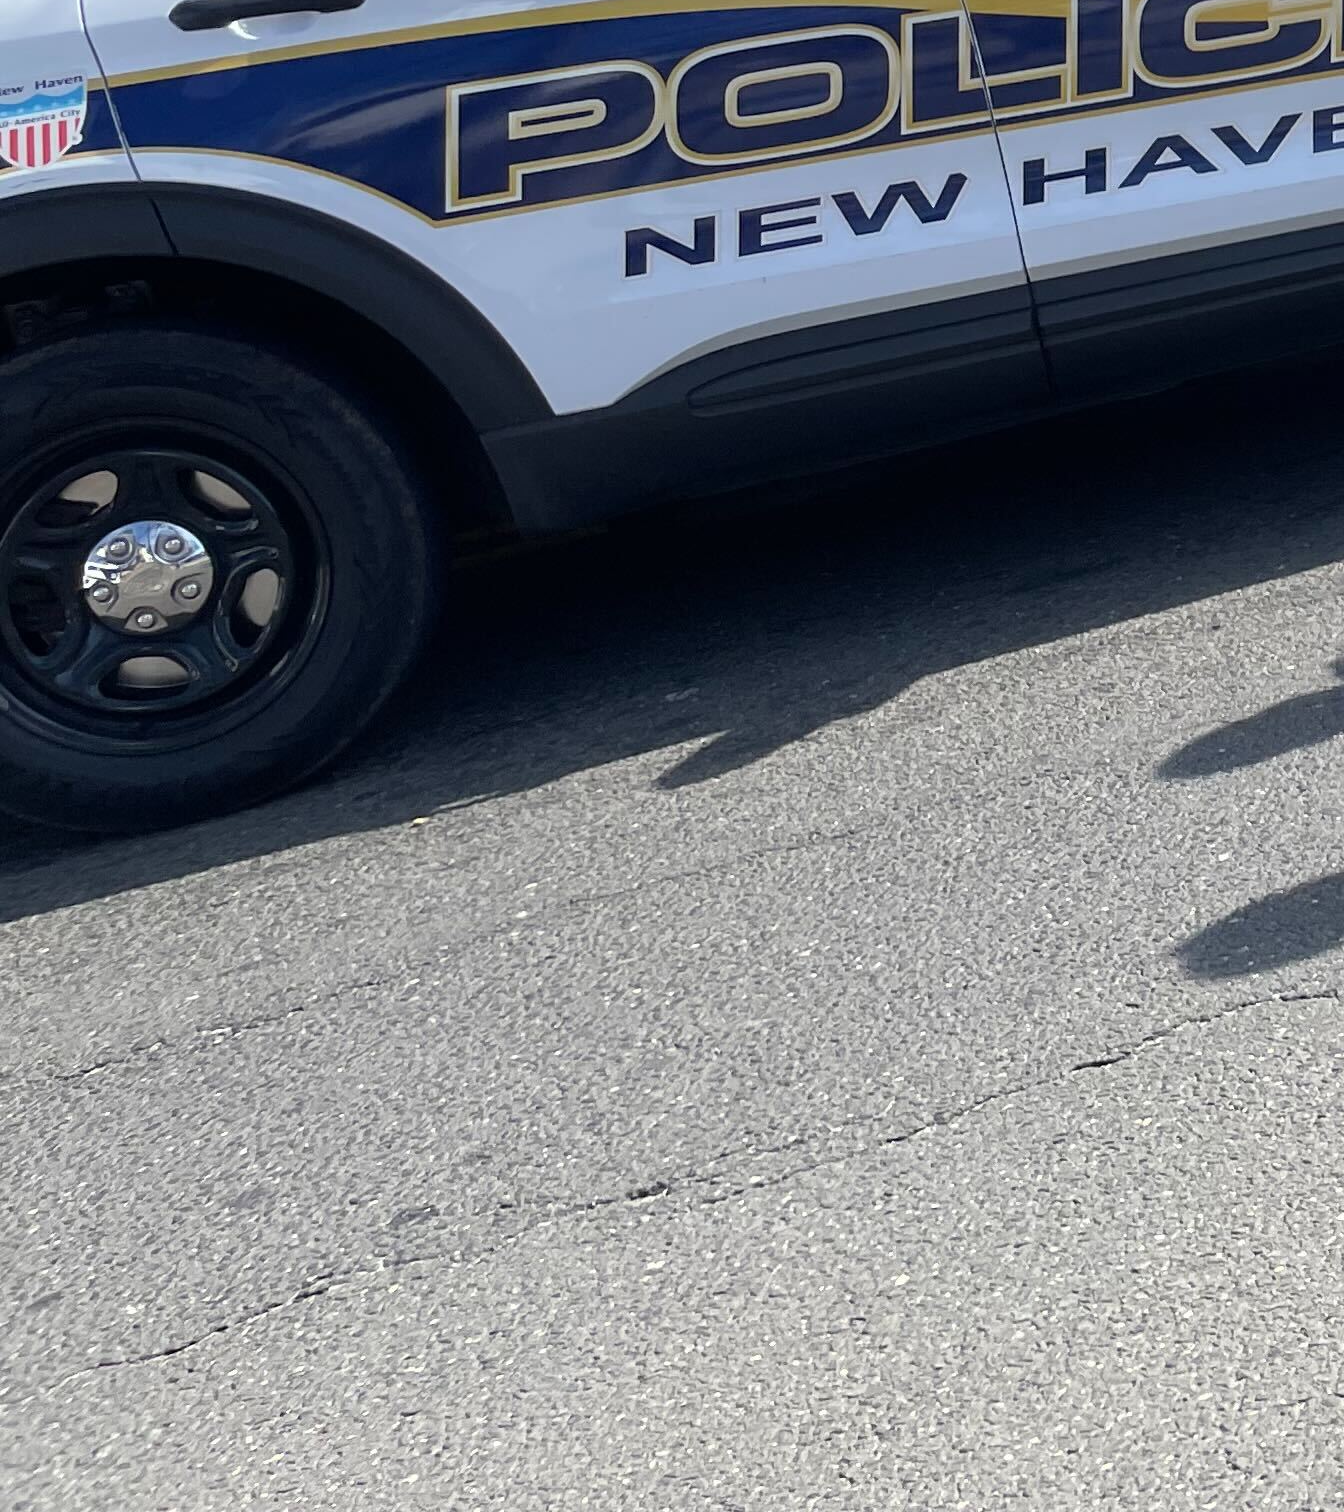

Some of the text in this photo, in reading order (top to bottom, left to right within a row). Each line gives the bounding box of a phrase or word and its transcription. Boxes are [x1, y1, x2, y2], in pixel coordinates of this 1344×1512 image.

[0, 75, 83, 96] ew Haven
[622, 172, 969, 280] NEW
